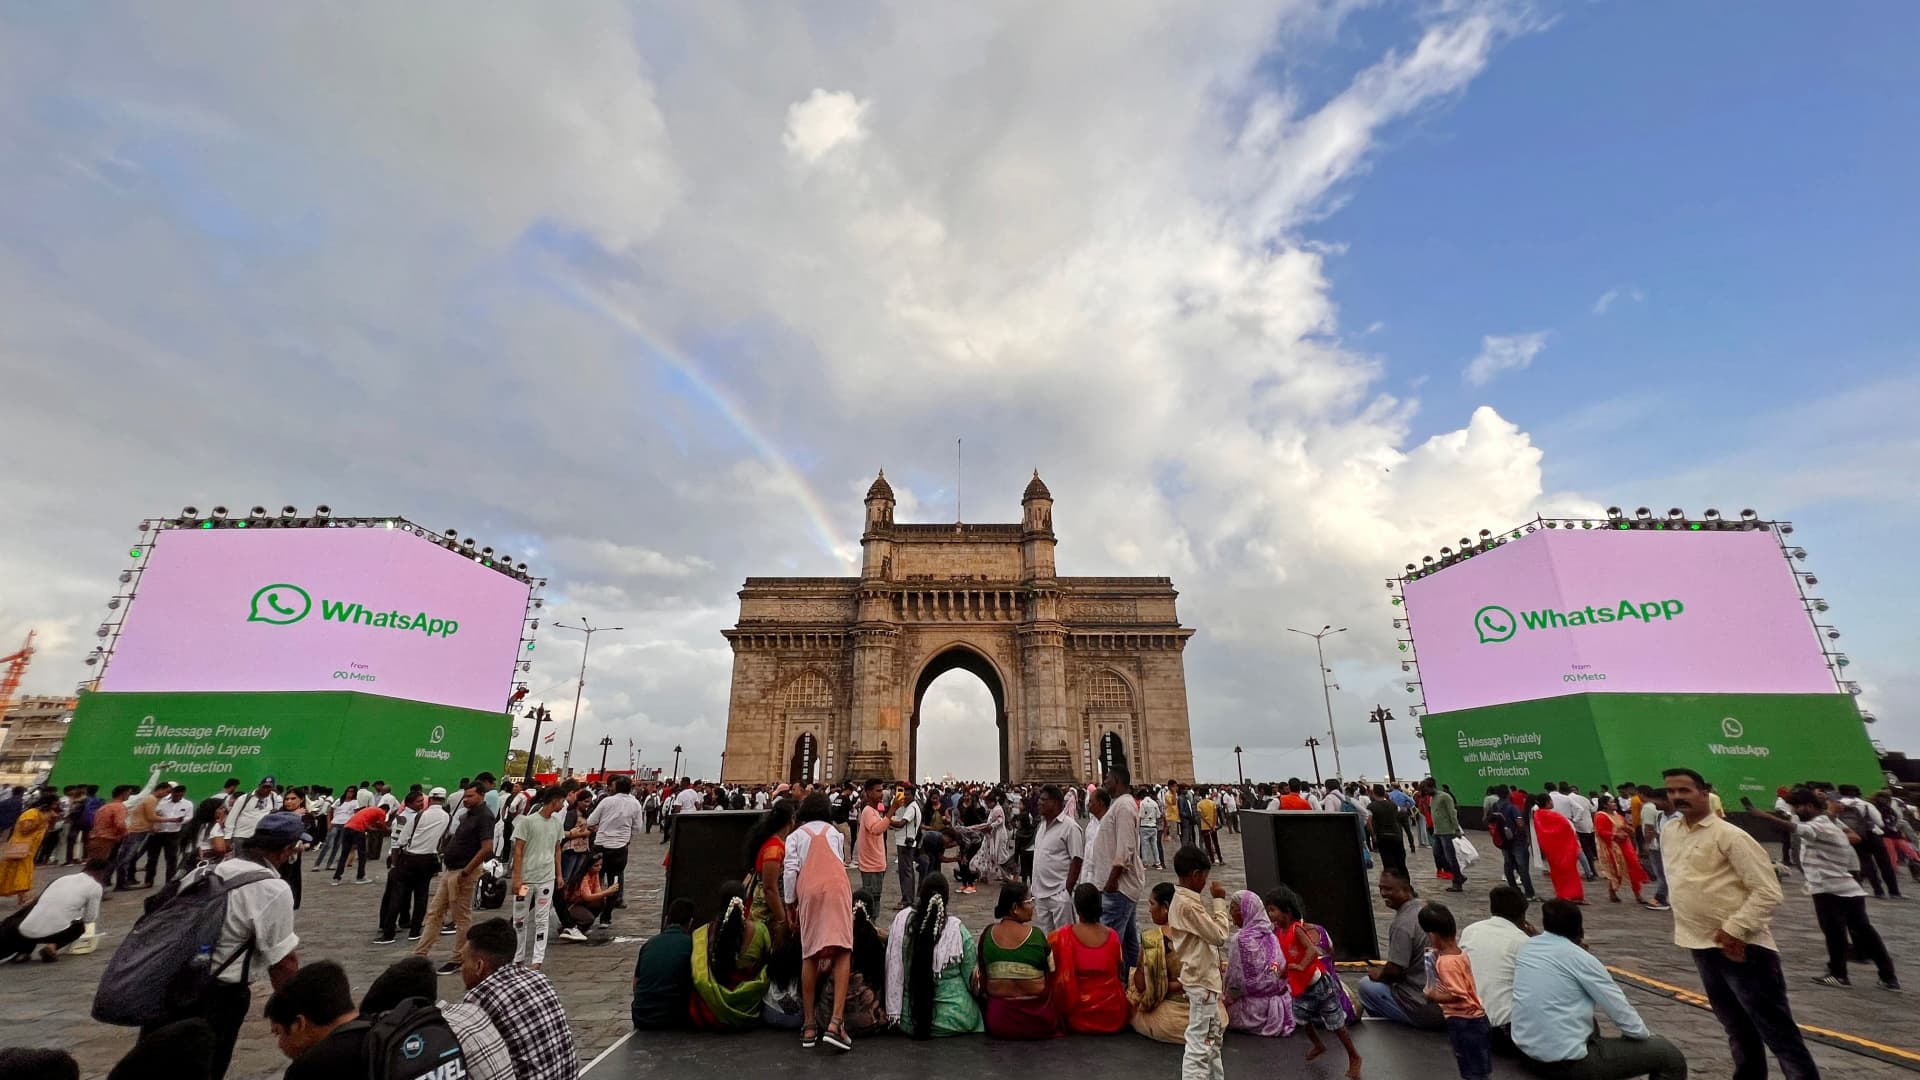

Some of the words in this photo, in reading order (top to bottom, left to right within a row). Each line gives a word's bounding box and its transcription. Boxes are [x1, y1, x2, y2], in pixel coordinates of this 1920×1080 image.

[320, 599, 459, 638] WhatsApp
[1520, 599, 1684, 630] WhatsApp
[350, 661, 369, 670] from
[349, 671, 376, 682] Meta
[1577, 672, 1607, 682] Meta
[154, 725, 213, 739] Message
[215, 724, 272, 740] Privately
[1467, 736, 1503, 748] Message
[1503, 731, 1542, 745] Privately
[133, 743, 160, 755] with
[163, 743, 215, 758] Multiple
[217, 742, 261, 758] Layers
[415, 747, 450, 760] WhatsApp
[1463, 752, 1479, 763] with
[1479, 750, 1511, 763] Multiple
[1512, 750, 1543, 762] Layers
[1707, 743, 1770, 758] WhatsApp
[166, 760, 233, 774] Protection
[1487, 766, 1530, 777] Protection
[414, 1058, 467, 1080] VEL
